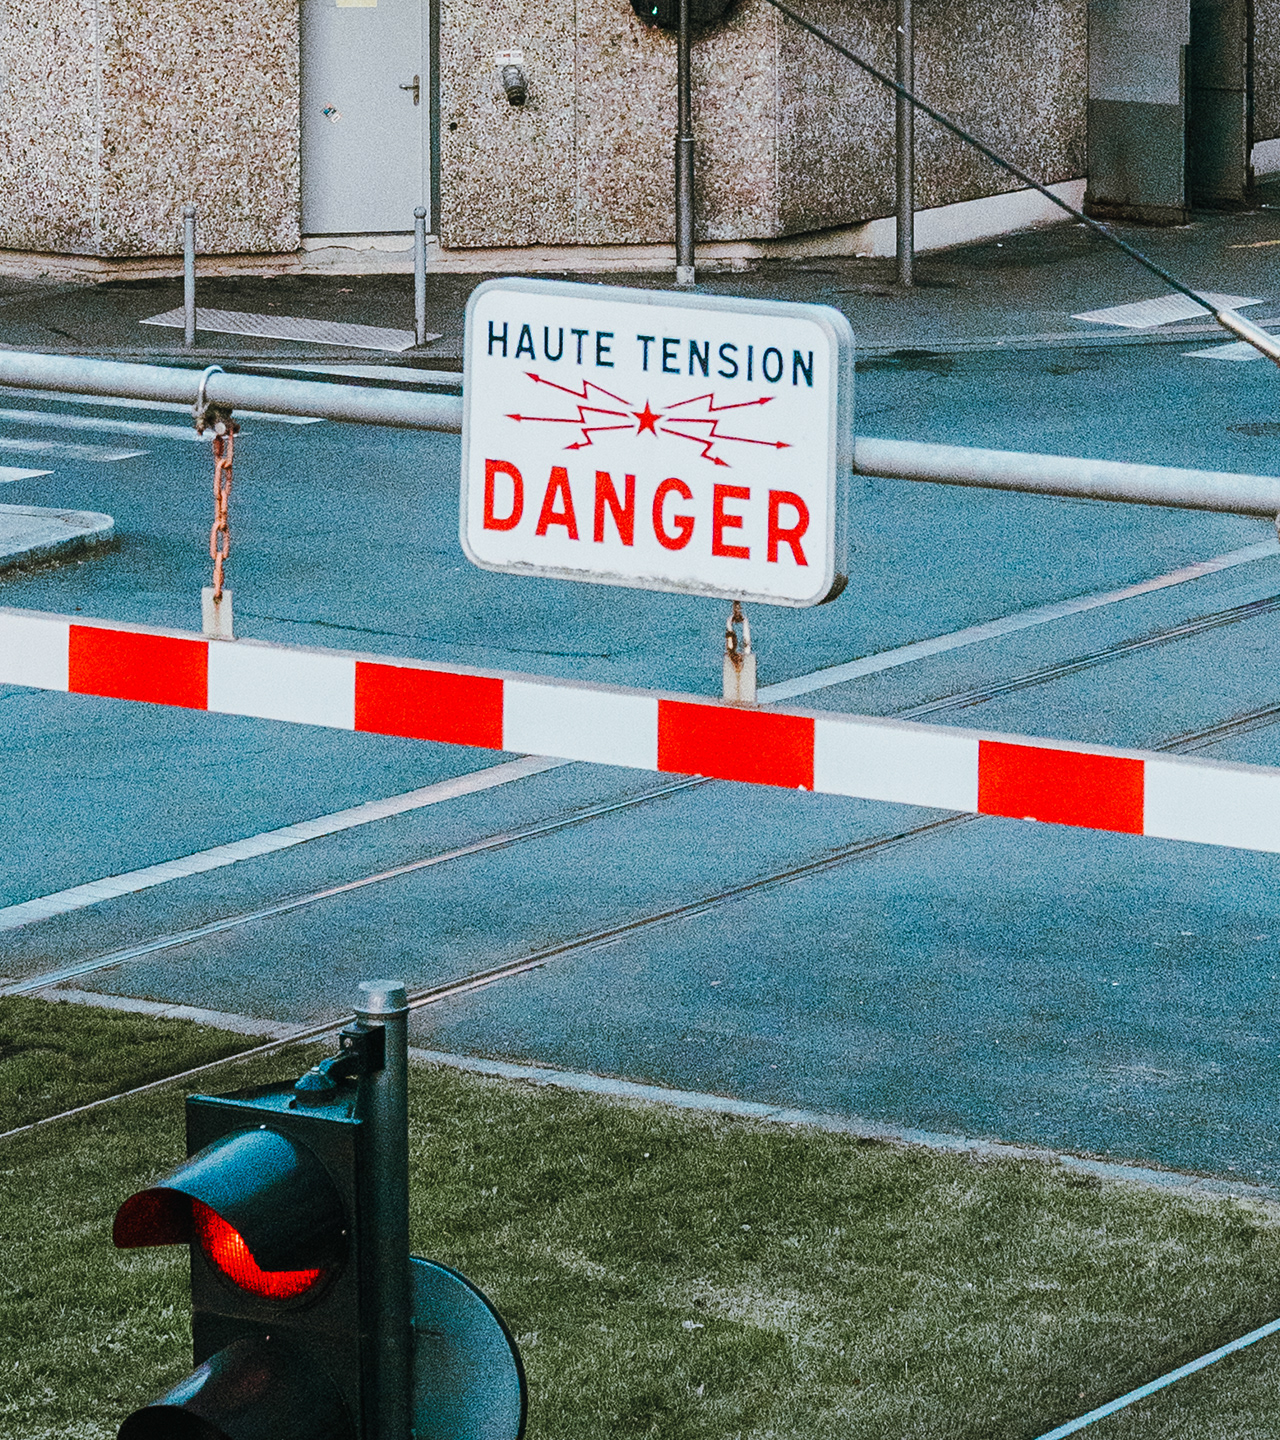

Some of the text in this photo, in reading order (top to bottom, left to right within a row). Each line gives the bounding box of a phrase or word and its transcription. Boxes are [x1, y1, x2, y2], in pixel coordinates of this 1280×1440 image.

[487, 320, 814, 387] HAUTE TENSION
[482, 457, 811, 568] DANGER
